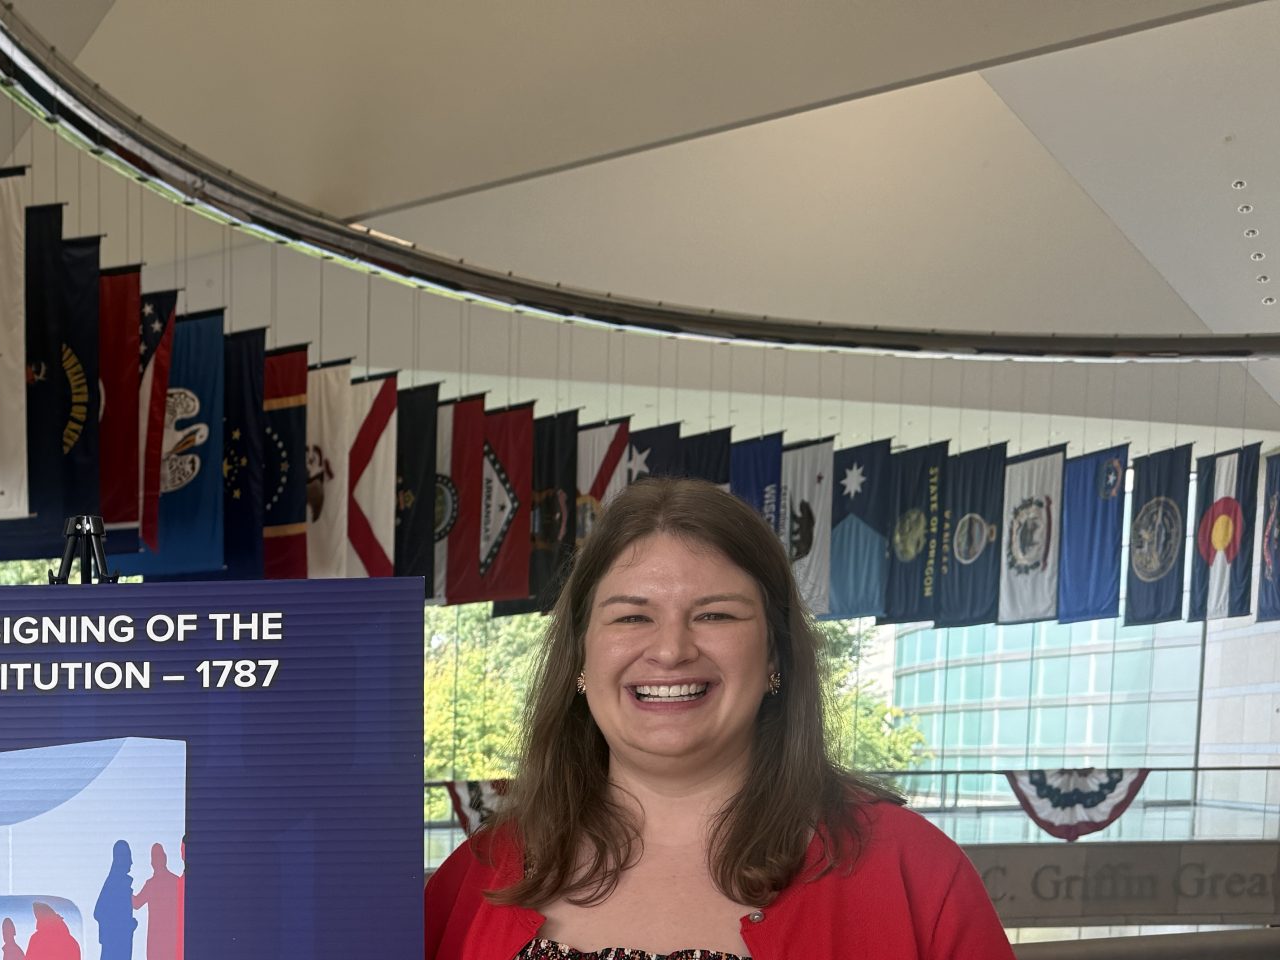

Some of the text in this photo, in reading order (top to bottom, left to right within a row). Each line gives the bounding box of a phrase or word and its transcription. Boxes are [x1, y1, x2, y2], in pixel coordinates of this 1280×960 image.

[146, 613, 198, 643] OF
[209, 612, 283, 641] THE
[195, 659, 280, 688] 1787
[1031, 861, 1159, 901] Griffin
[1173, 861, 1280, 899] Grea
